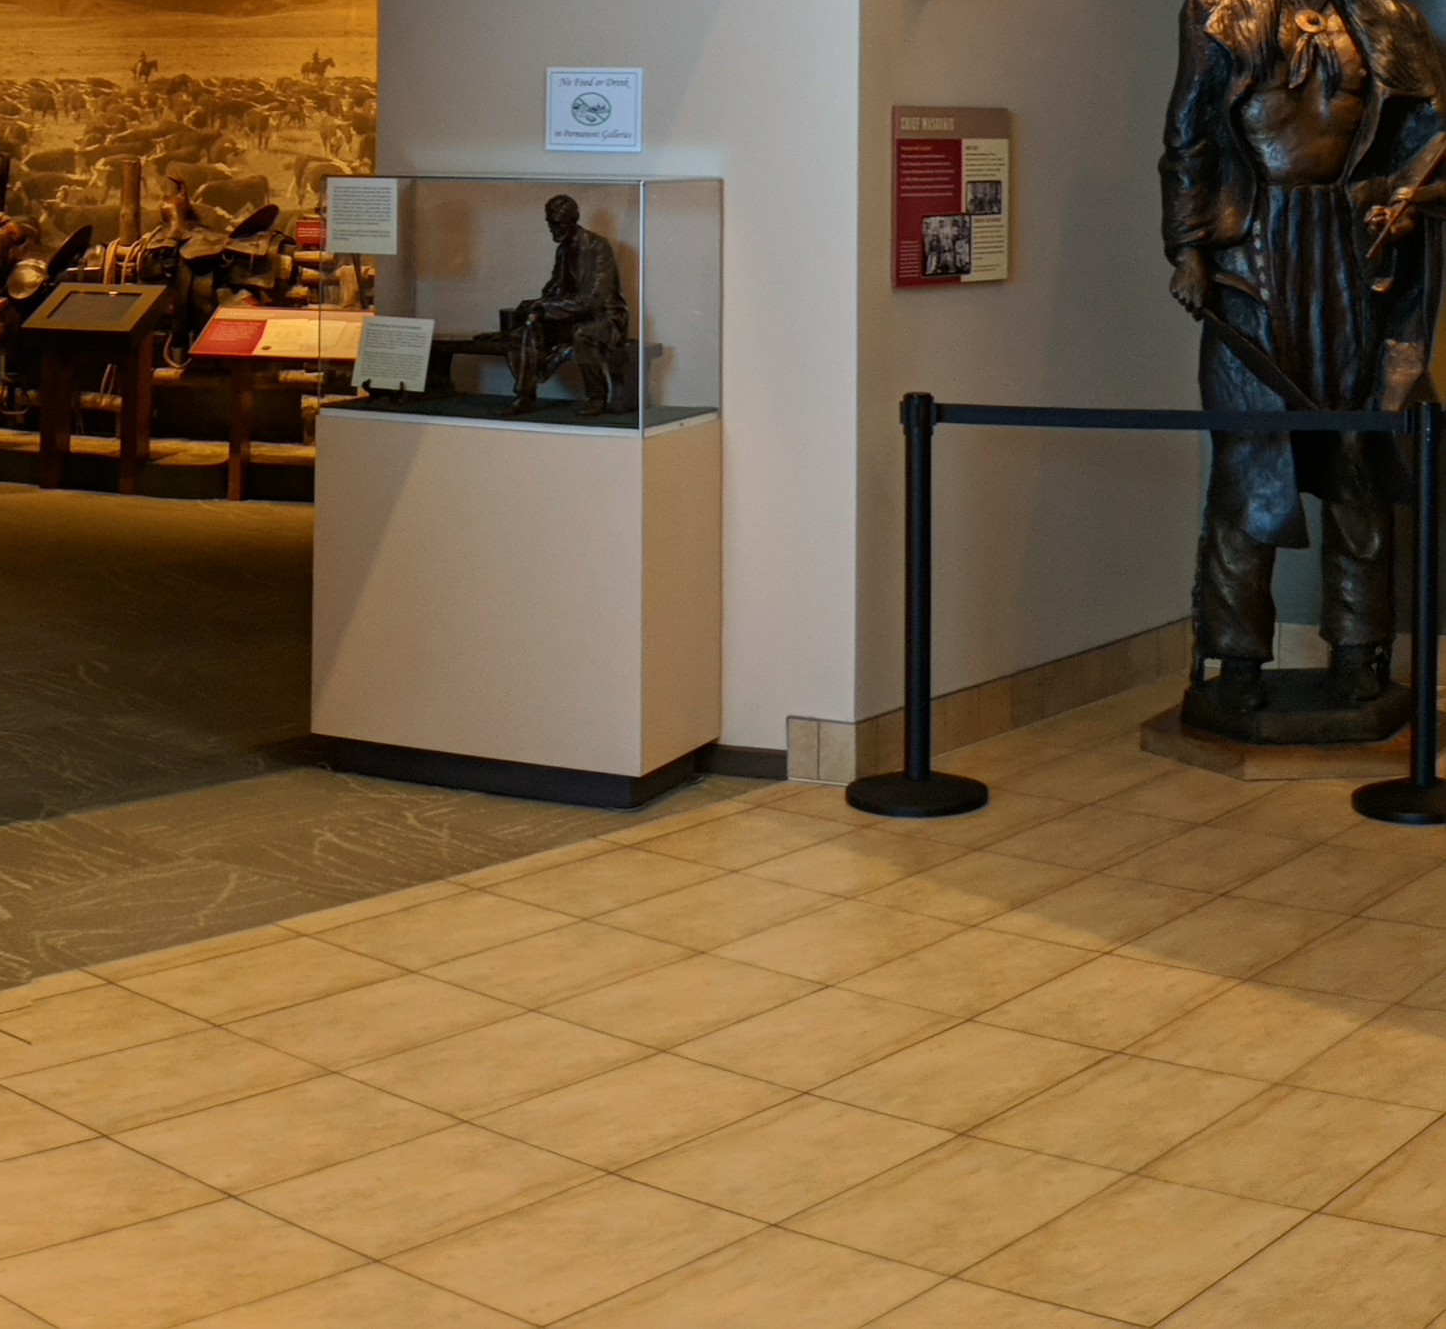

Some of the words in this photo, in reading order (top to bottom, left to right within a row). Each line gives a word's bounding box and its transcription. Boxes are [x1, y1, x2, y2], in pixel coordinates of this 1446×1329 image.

[558, 78, 572, 88] No
[574, 77, 594, 87] Food
[595, 79, 604, 87] or
[605, 77, 631, 89] Drink
[563, 129, 600, 138] Permanent
[601, 129, 632, 140] Galleries
